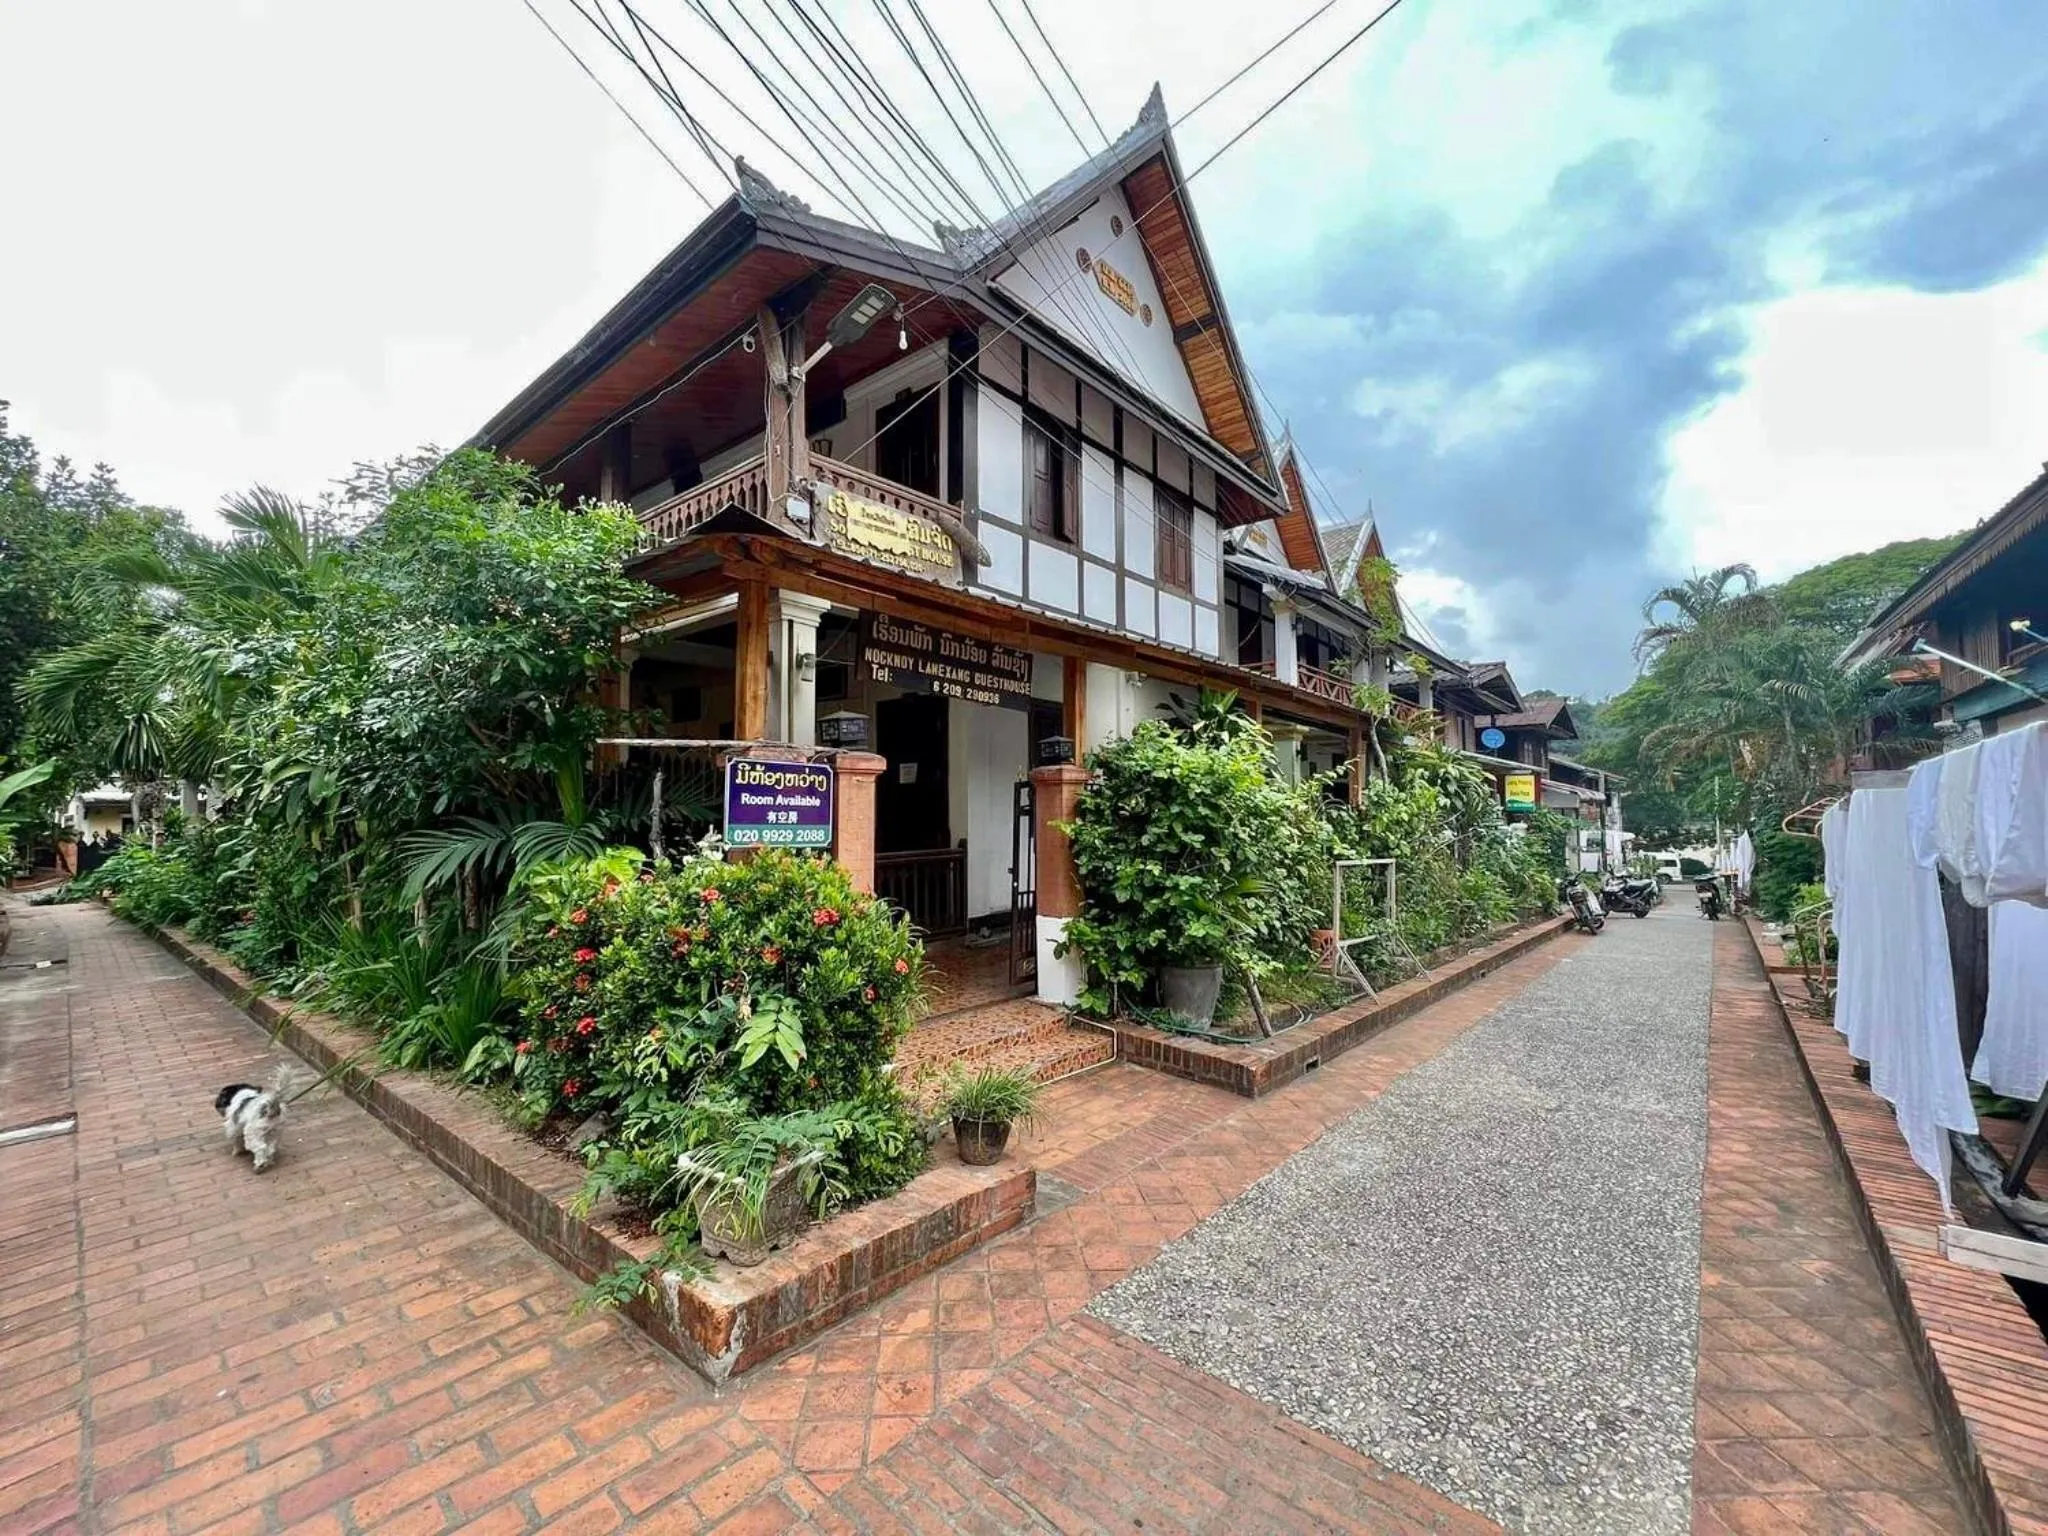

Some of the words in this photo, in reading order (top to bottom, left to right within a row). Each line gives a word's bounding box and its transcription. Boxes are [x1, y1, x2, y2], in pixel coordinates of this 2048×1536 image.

[865, 647, 914, 671] NOCKNOY
[974, 672, 1031, 695] GUESTHOUSE
[871, 664, 893, 682] Tel:
[741, 792, 774, 805] Room
[775, 795, 821, 807] Available
[766, 811, 798, 824] 有空房
[734, 829, 758, 841] 020
[762, 829, 793, 842] 9929
[796, 829, 825, 842] 2088
